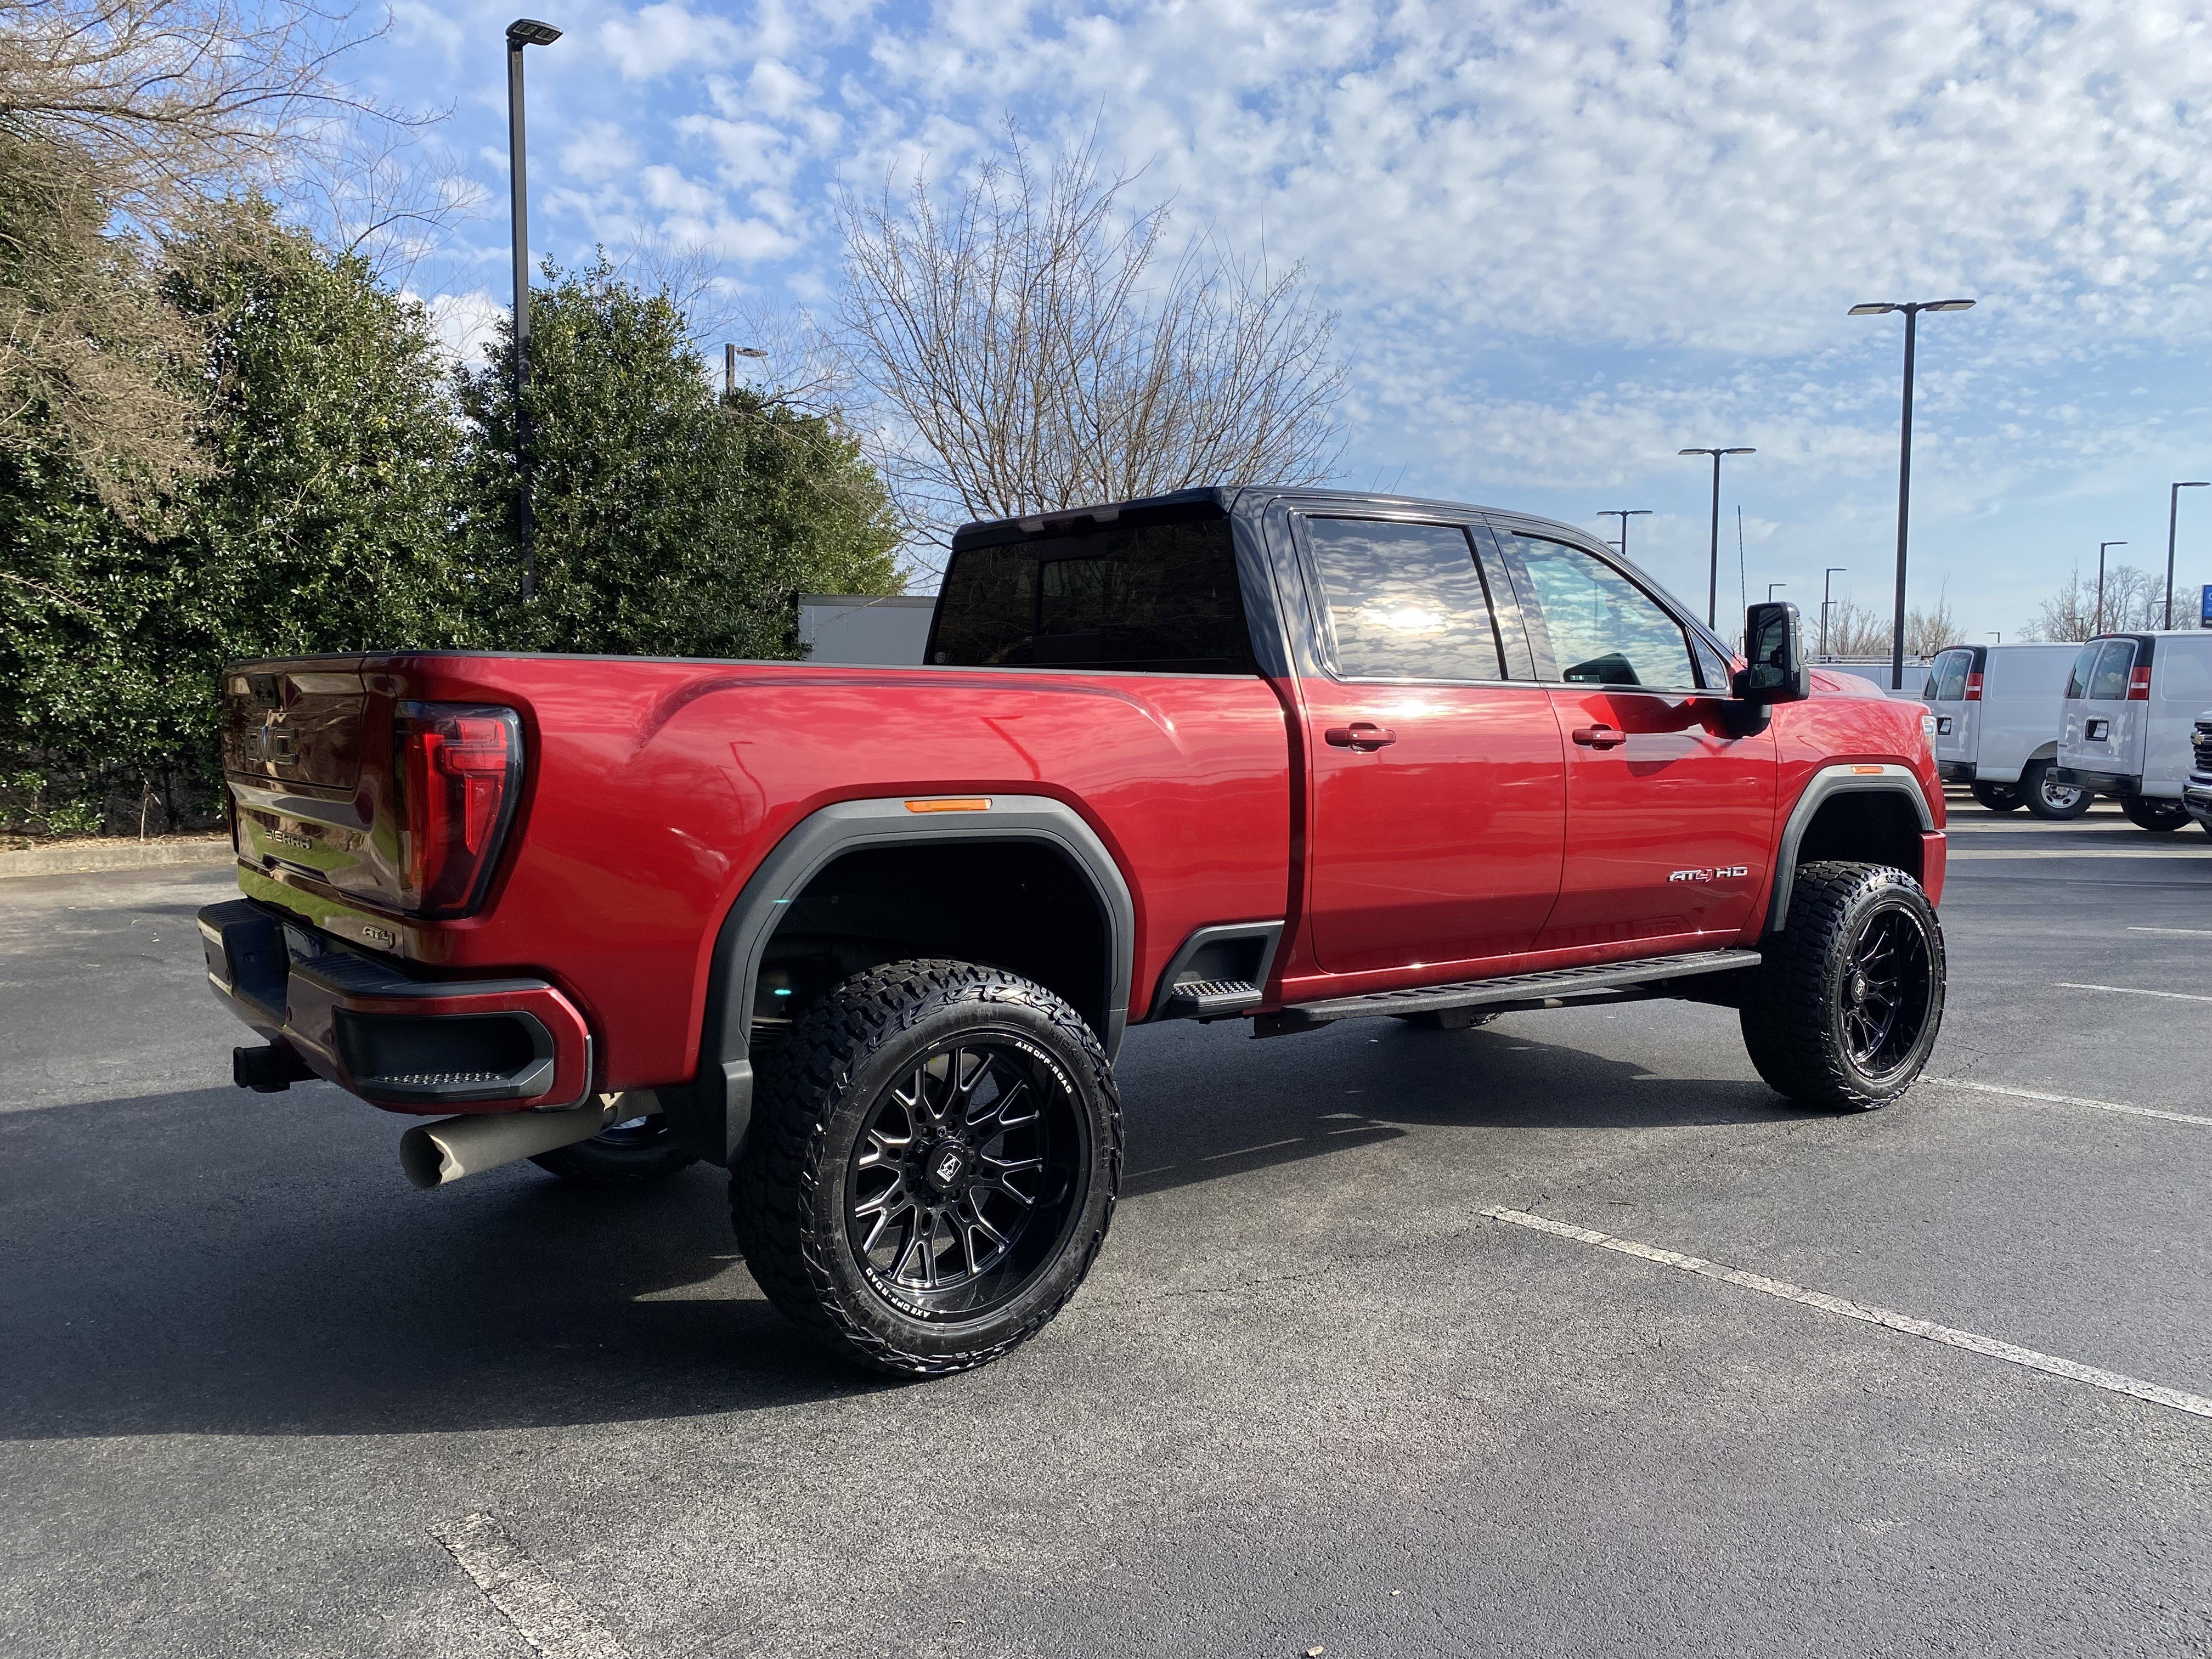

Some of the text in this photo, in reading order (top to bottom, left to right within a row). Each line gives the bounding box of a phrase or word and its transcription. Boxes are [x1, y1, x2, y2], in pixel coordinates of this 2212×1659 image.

[266, 830, 312, 849] SIERRA
[1667, 867, 1748, 883] AT4 HD
[363, 924, 395, 949] AT4
[1015, 1041, 1071, 1094] AXE OFF-ROAD
[866, 1267, 930, 1318] AXE OFF-ROAD
